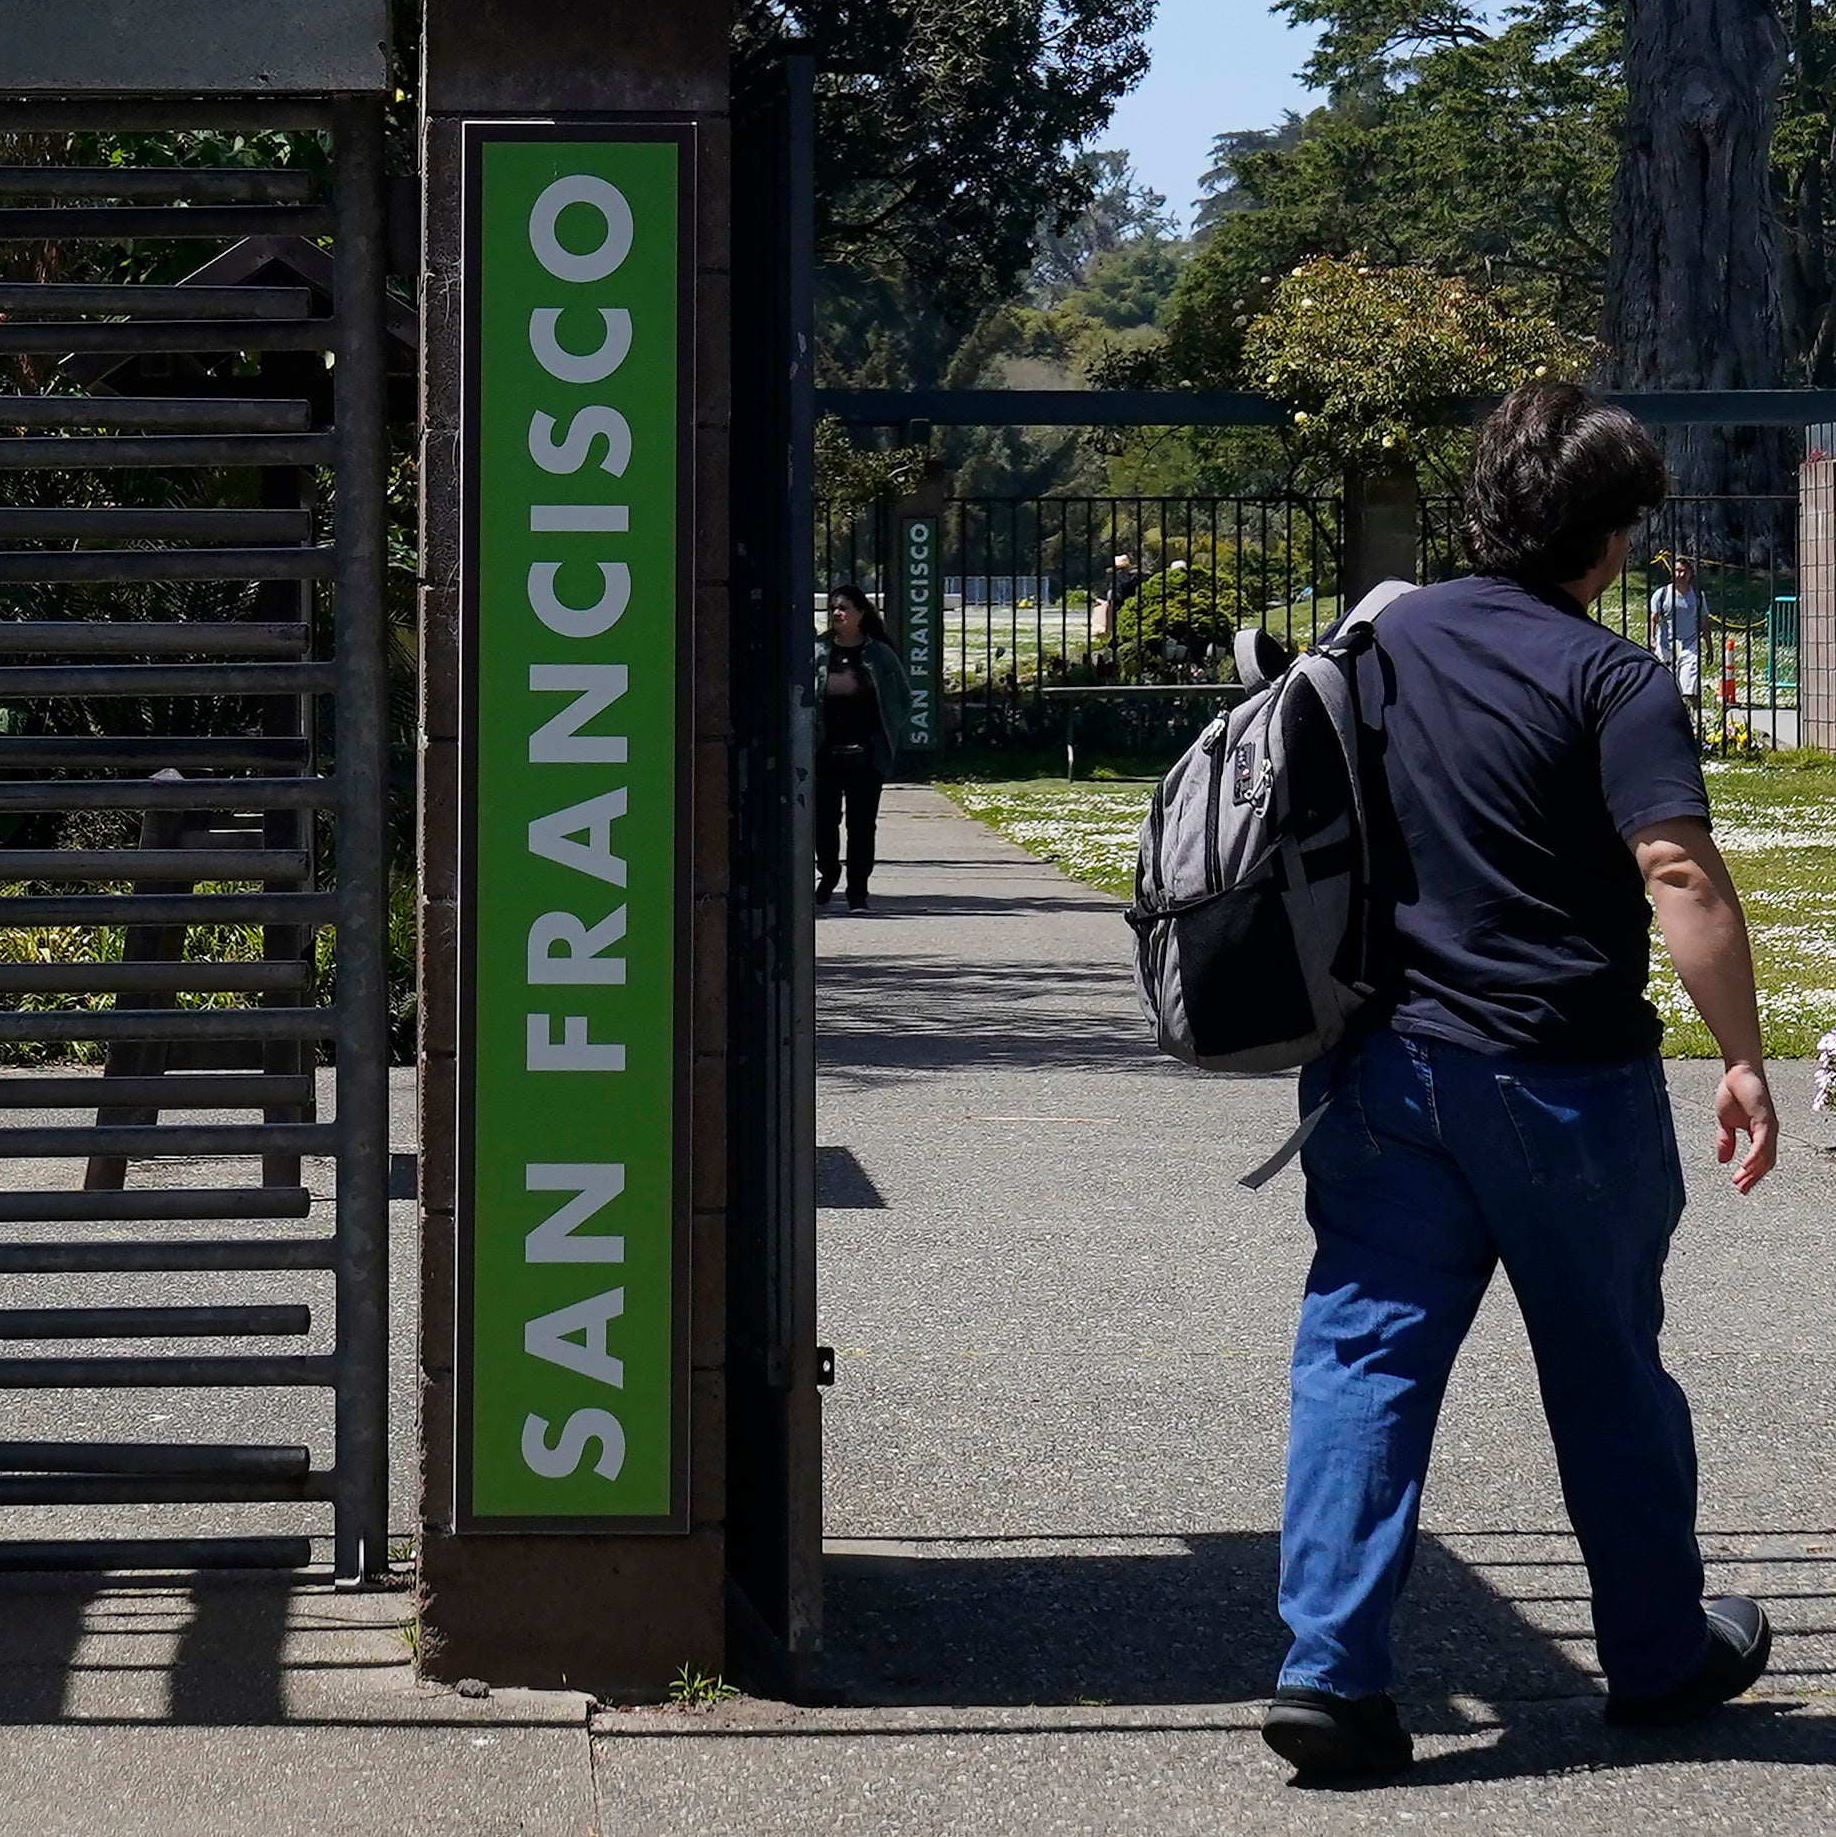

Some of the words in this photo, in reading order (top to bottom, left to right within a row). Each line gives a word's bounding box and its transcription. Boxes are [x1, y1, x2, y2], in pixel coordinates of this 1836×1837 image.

[525, 174, 634, 1072] FRANCISCO
[909, 522, 929, 676] FRANCISCO
[909, 689, 929, 745] SAN
[521, 1163, 627, 1482] SAN
